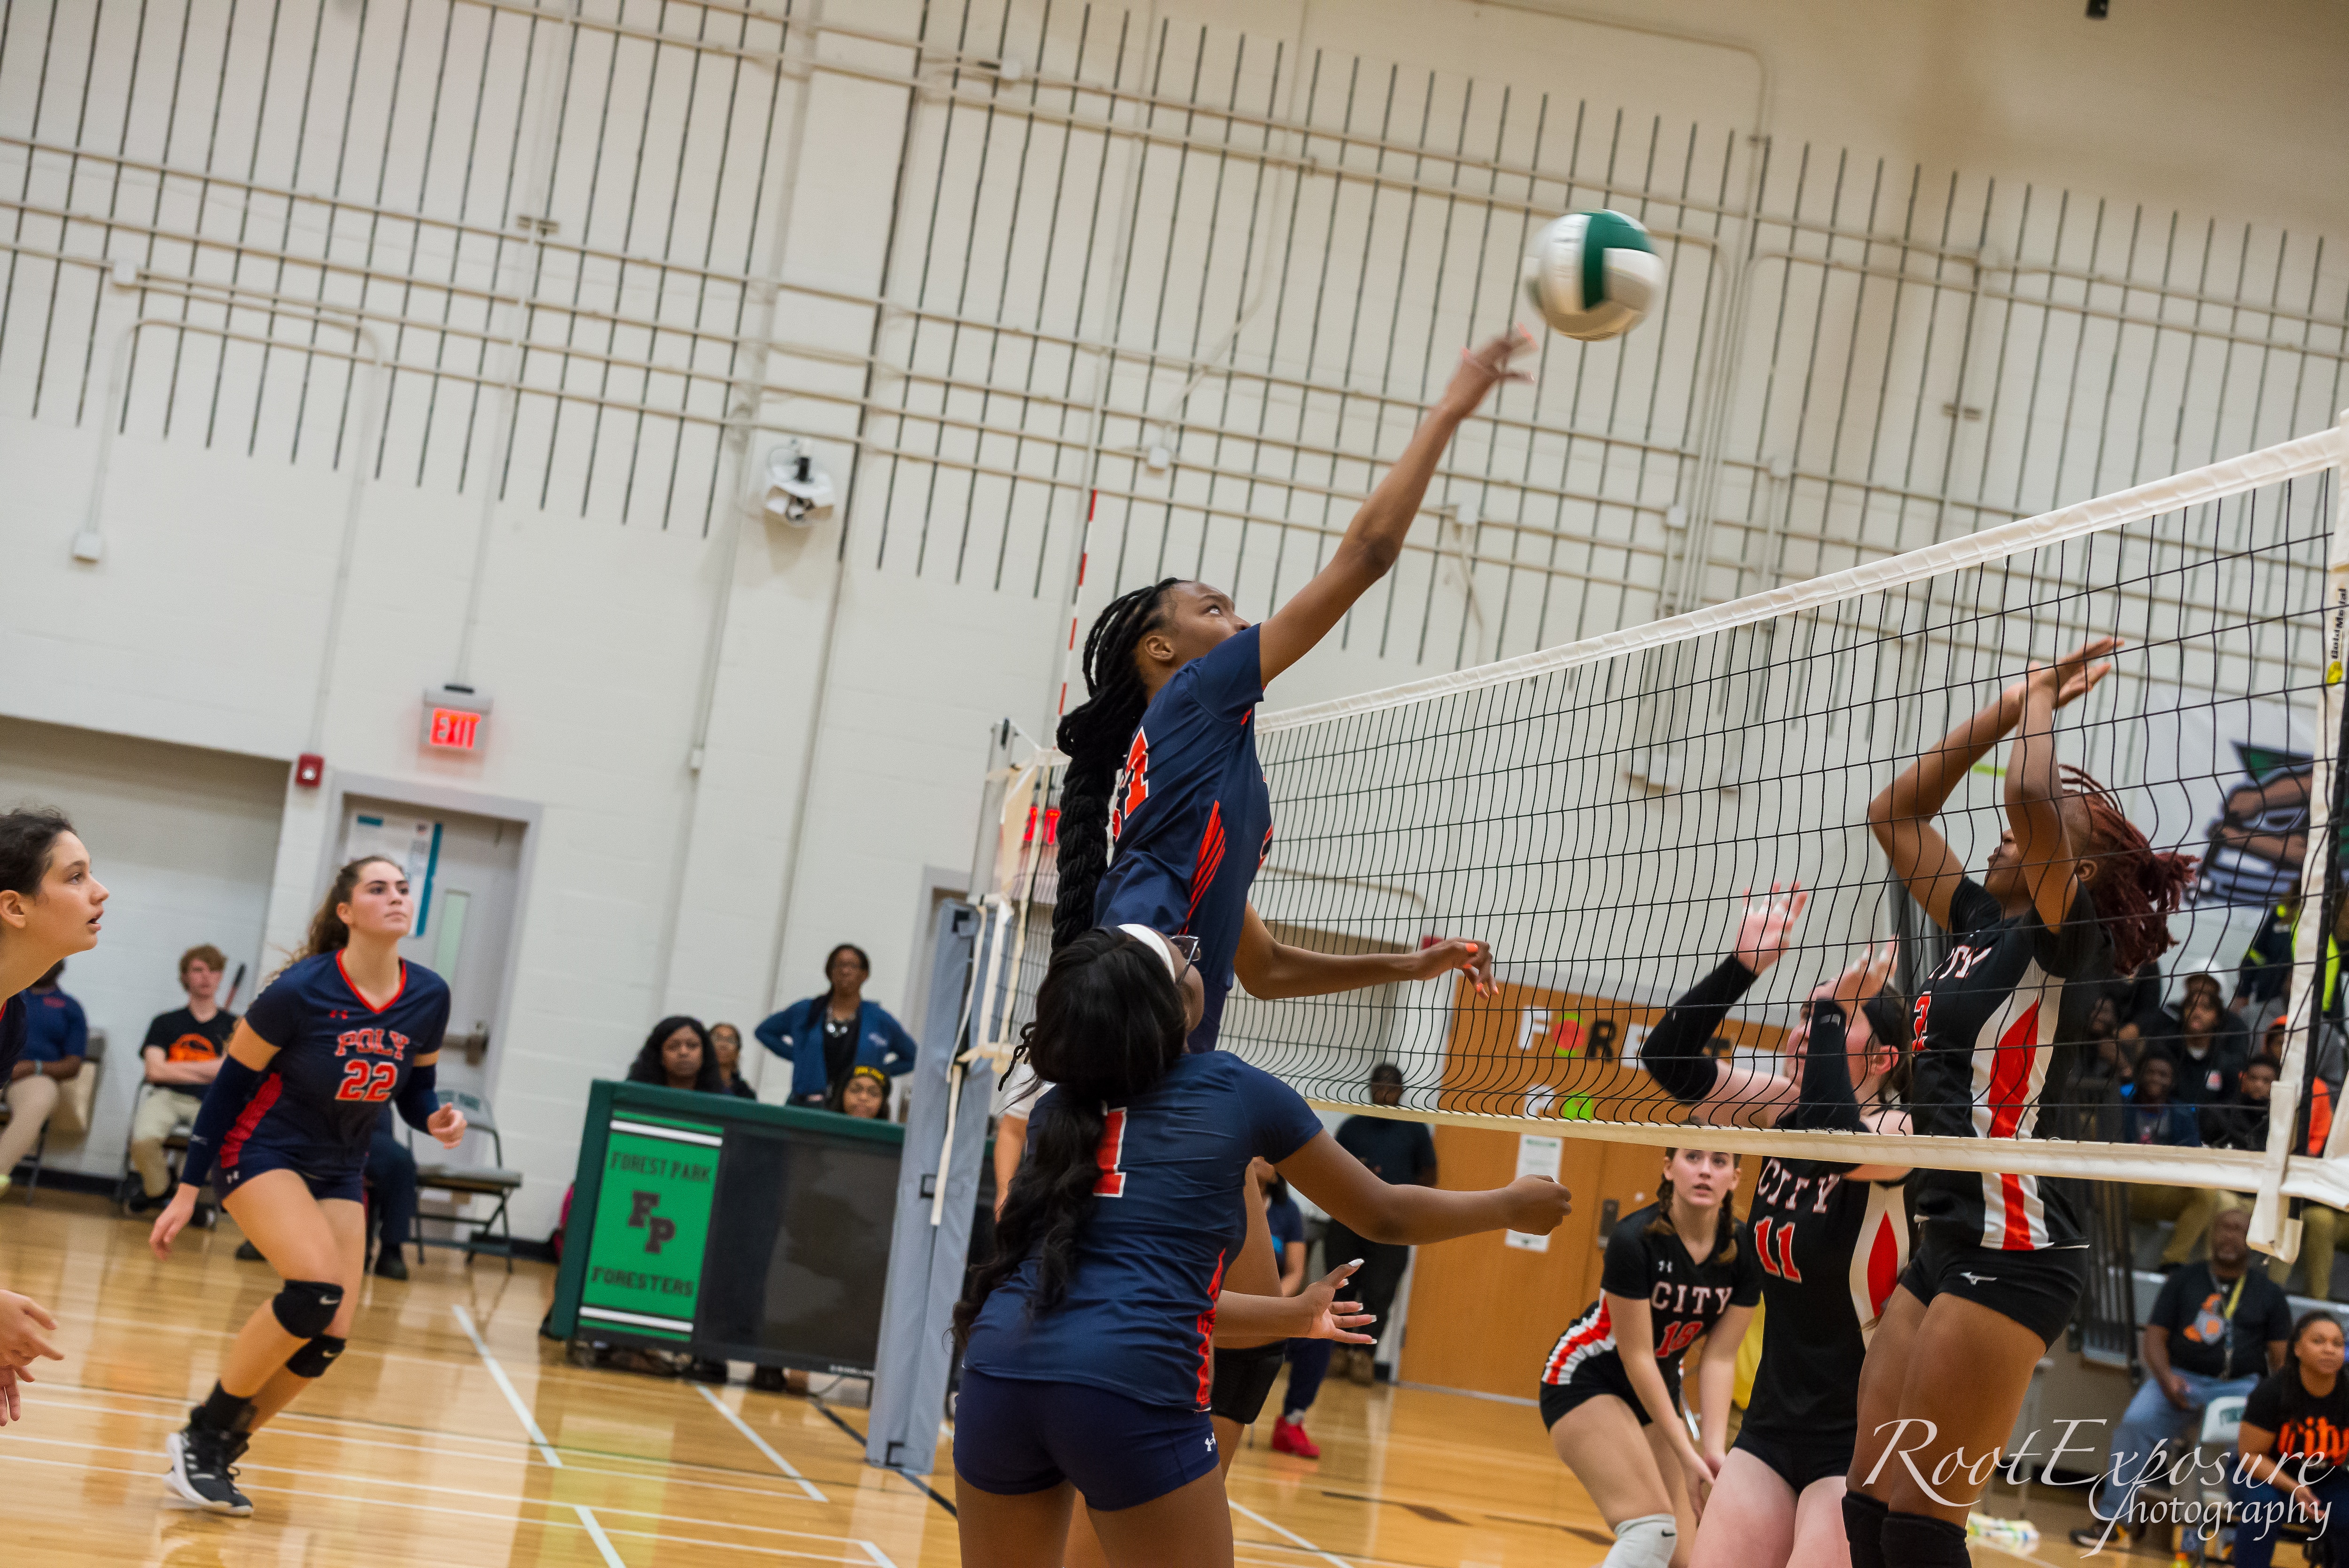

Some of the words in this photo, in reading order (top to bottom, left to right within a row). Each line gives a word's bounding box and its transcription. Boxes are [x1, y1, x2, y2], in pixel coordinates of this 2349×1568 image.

[429, 707, 482, 750] EXIT
[334, 1027, 410, 1061] POLY
[334, 1059, 398, 1102] 22
[611, 1151, 667, 1176] FOREST
[670, 1160, 711, 1183] PARK
[1758, 1157, 1840, 1213] CITY
[1754, 1215, 1802, 1284] 11
[591, 1266, 694, 1297] FORESTERS
[1651, 1281, 1734, 1315] CITY
